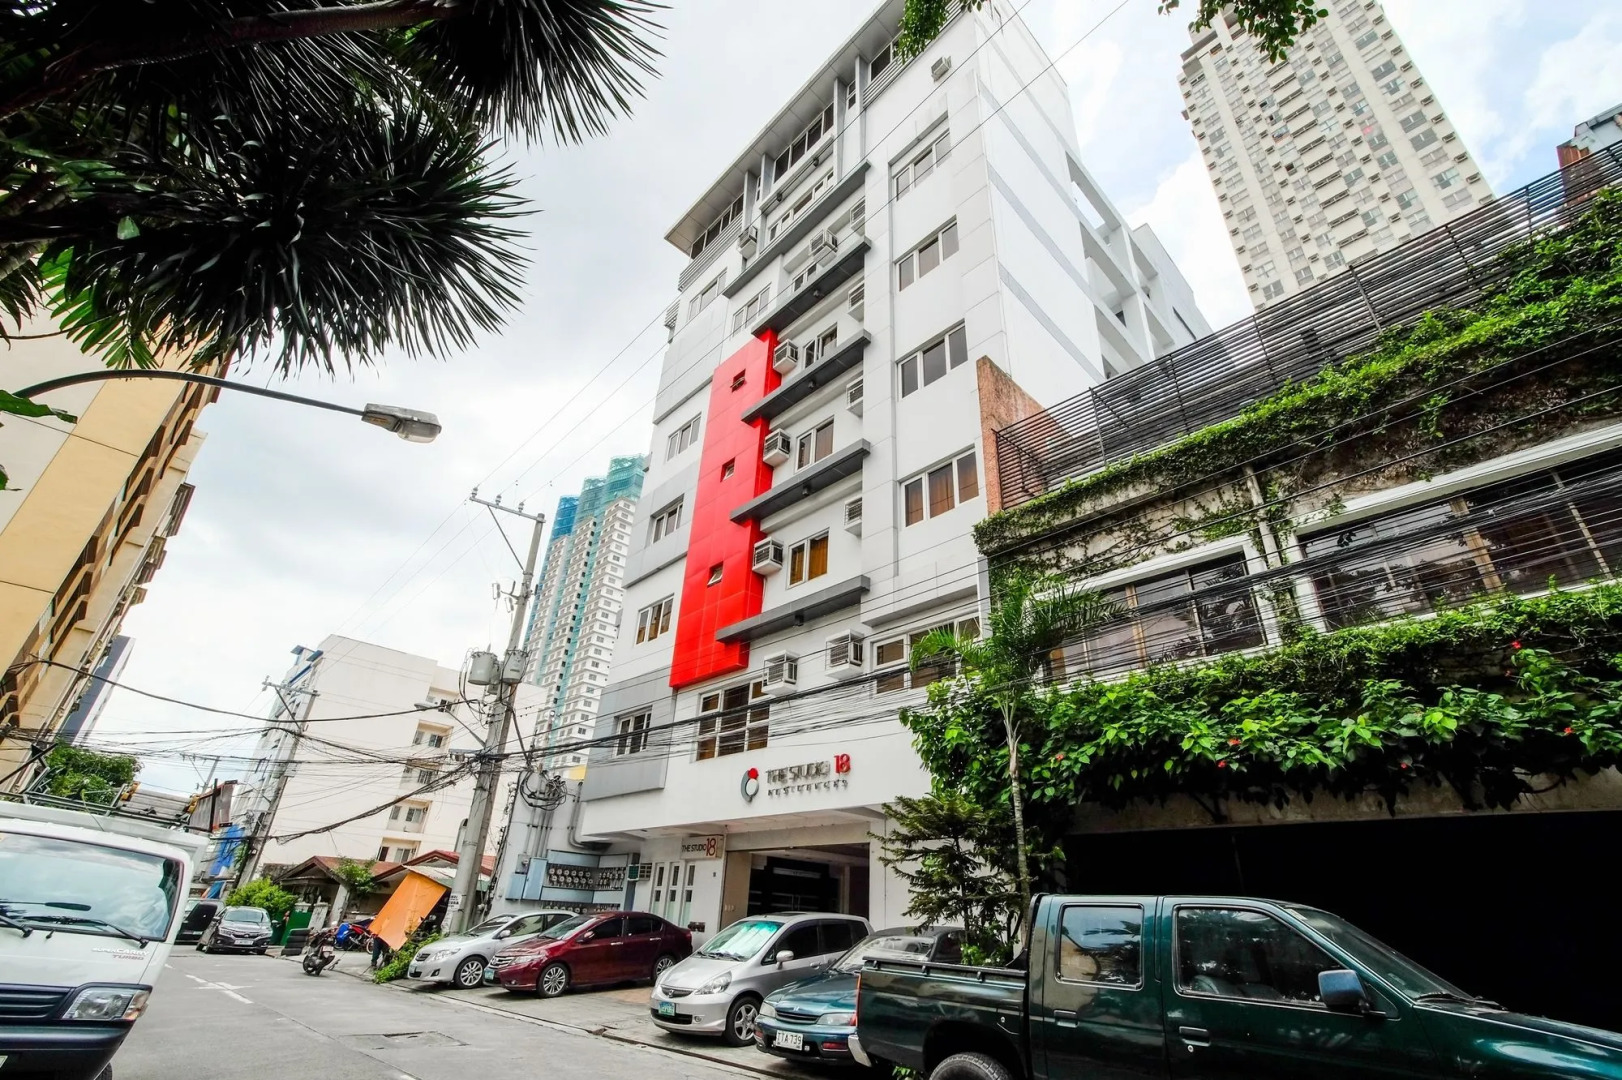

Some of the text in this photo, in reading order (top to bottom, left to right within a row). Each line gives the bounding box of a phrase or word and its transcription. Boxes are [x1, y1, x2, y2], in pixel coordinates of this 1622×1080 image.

[766, 753, 851, 783] THE STUDIO 18
[681, 837, 717, 857] THE STUDIO 18
